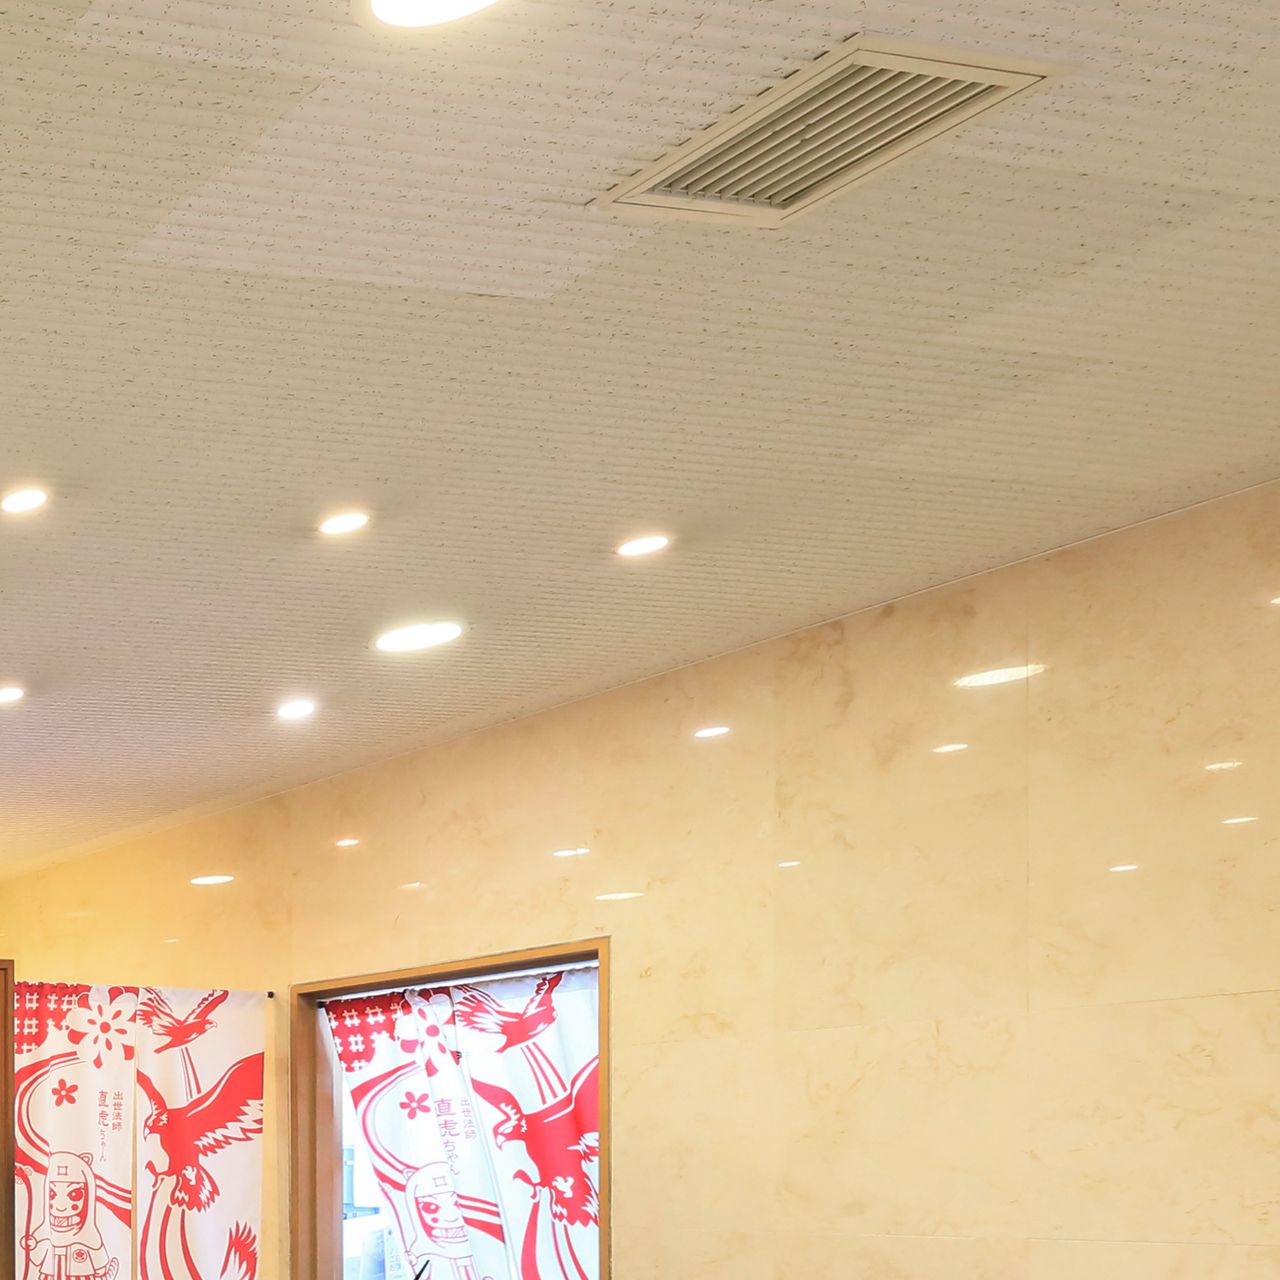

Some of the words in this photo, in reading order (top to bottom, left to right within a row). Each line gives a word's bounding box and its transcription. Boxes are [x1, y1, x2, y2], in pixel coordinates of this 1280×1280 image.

[434, 1098, 460, 1175] 直虎ちゃん
